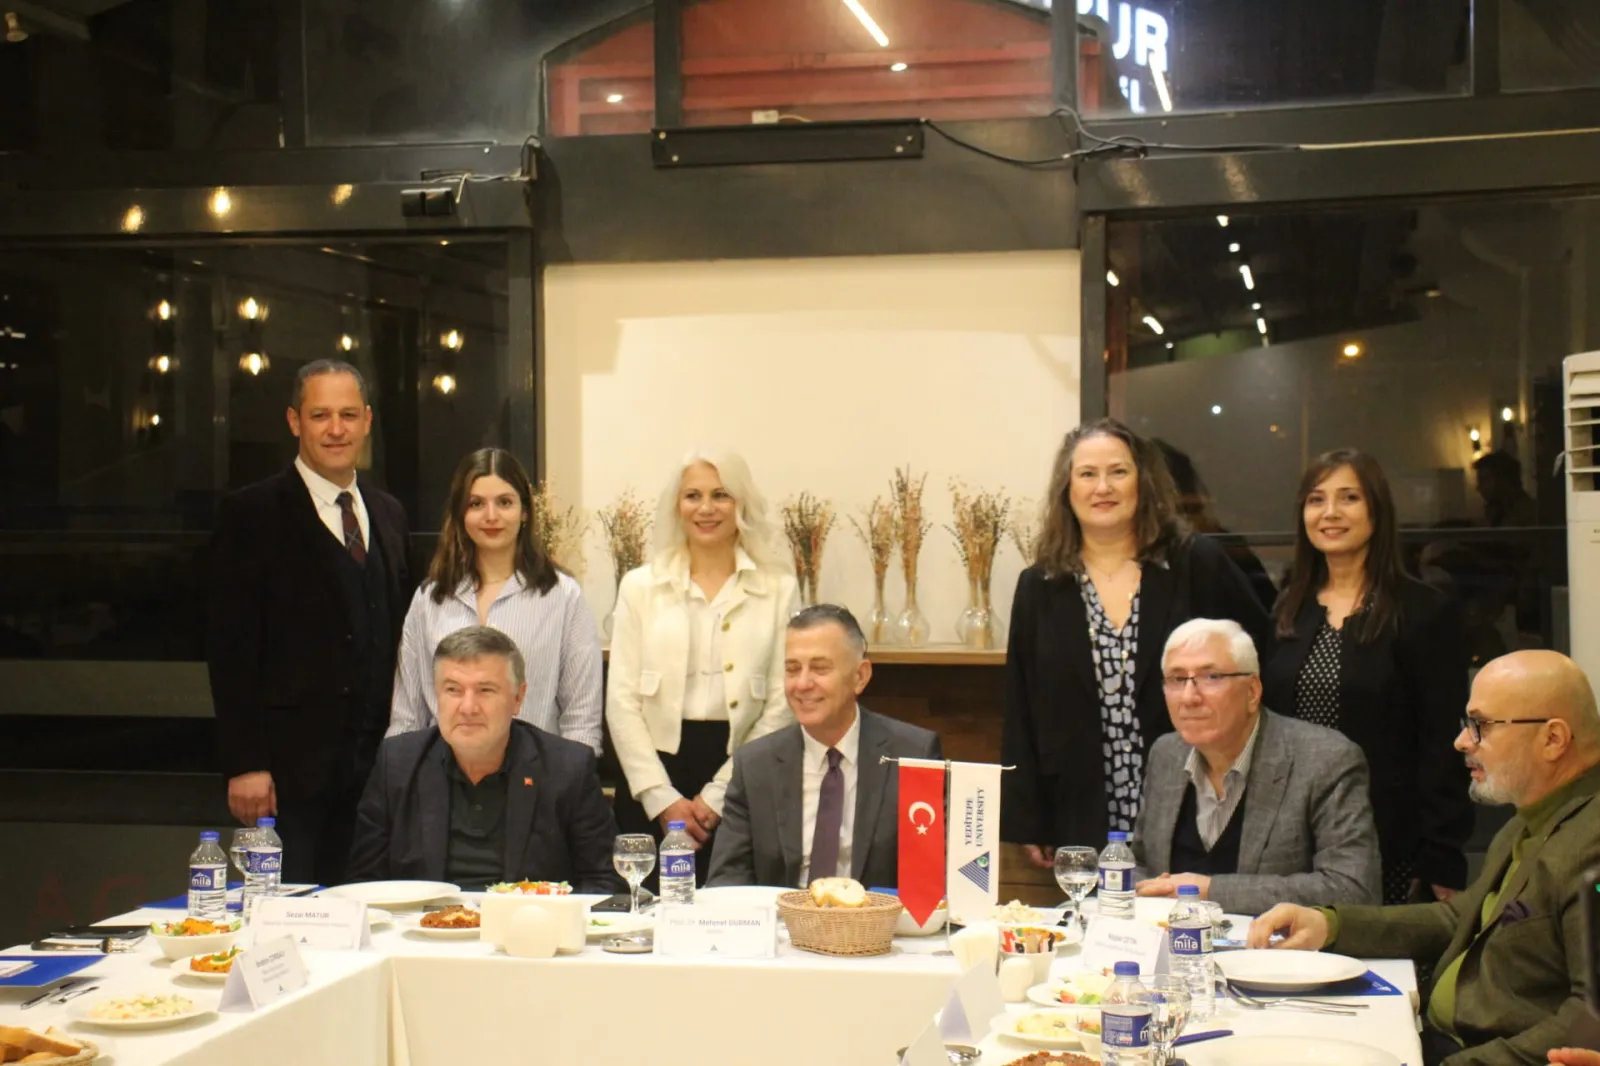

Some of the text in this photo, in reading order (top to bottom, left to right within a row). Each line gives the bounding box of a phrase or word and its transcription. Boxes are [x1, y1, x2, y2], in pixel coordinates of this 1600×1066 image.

[261, 859, 280, 870] mila
[671, 862, 691, 873] mila
[191, 876, 212, 886] mila
[1174, 938, 1198, 950] mila
